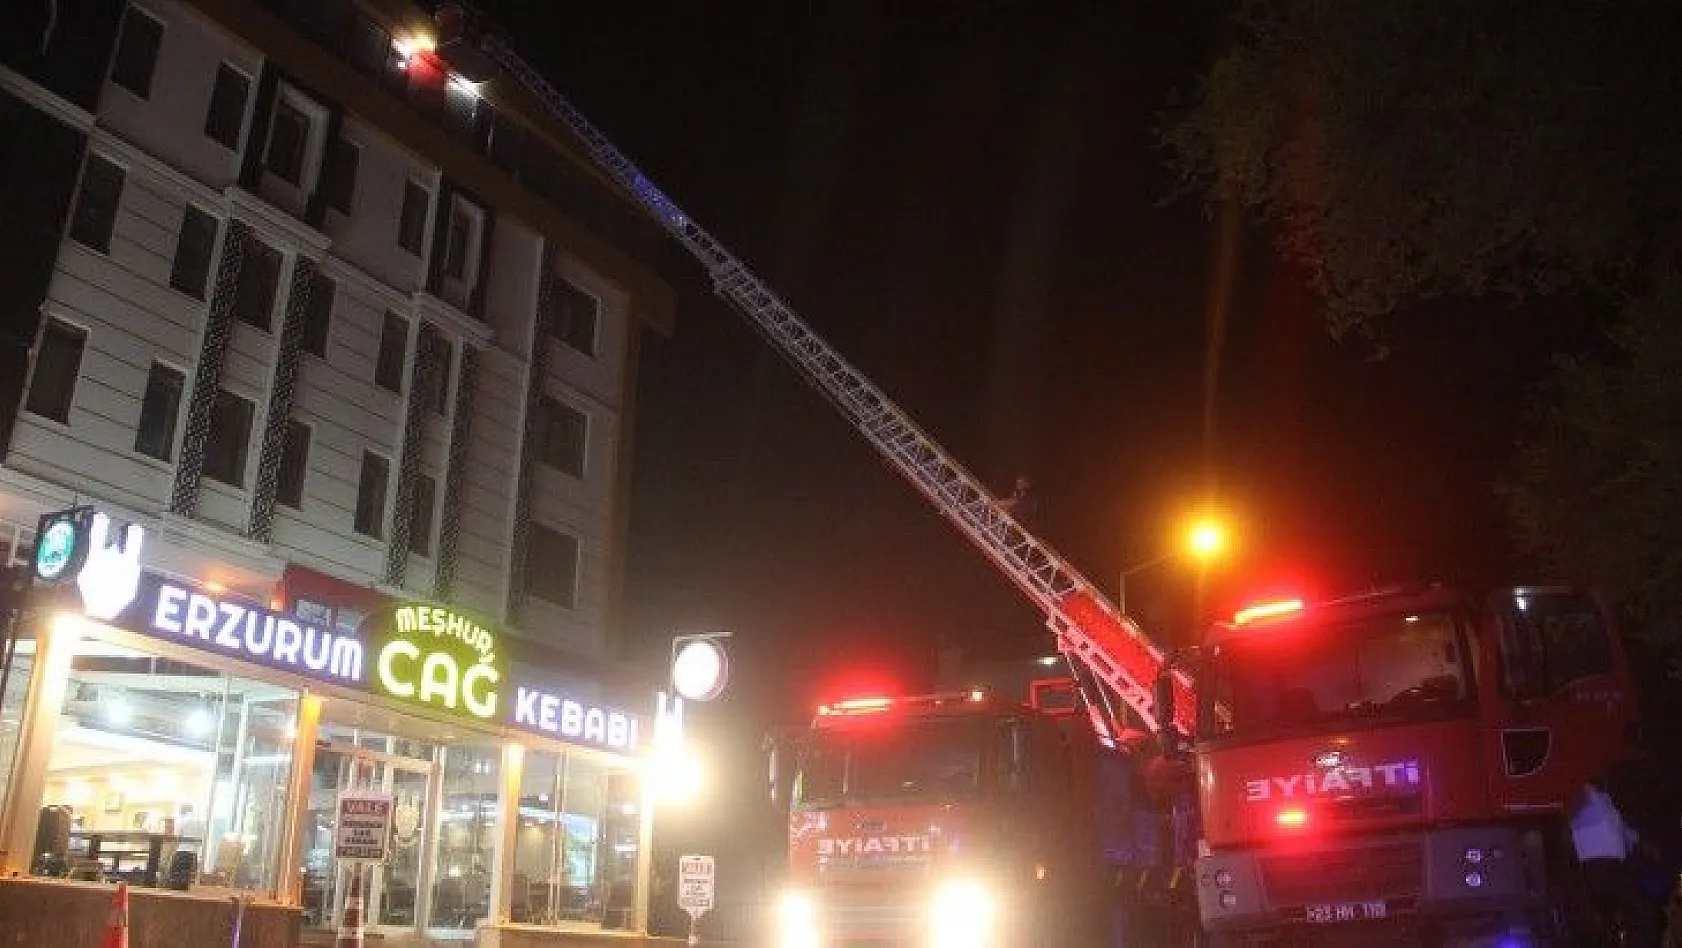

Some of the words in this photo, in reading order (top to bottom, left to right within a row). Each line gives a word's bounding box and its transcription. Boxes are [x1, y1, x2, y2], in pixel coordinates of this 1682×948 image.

[155, 584, 362, 681] ERZURUM
[396, 606, 494, 651] MEŞHUR
[378, 638, 499, 718] CAĞ
[515, 686, 638, 750] KEBABI
